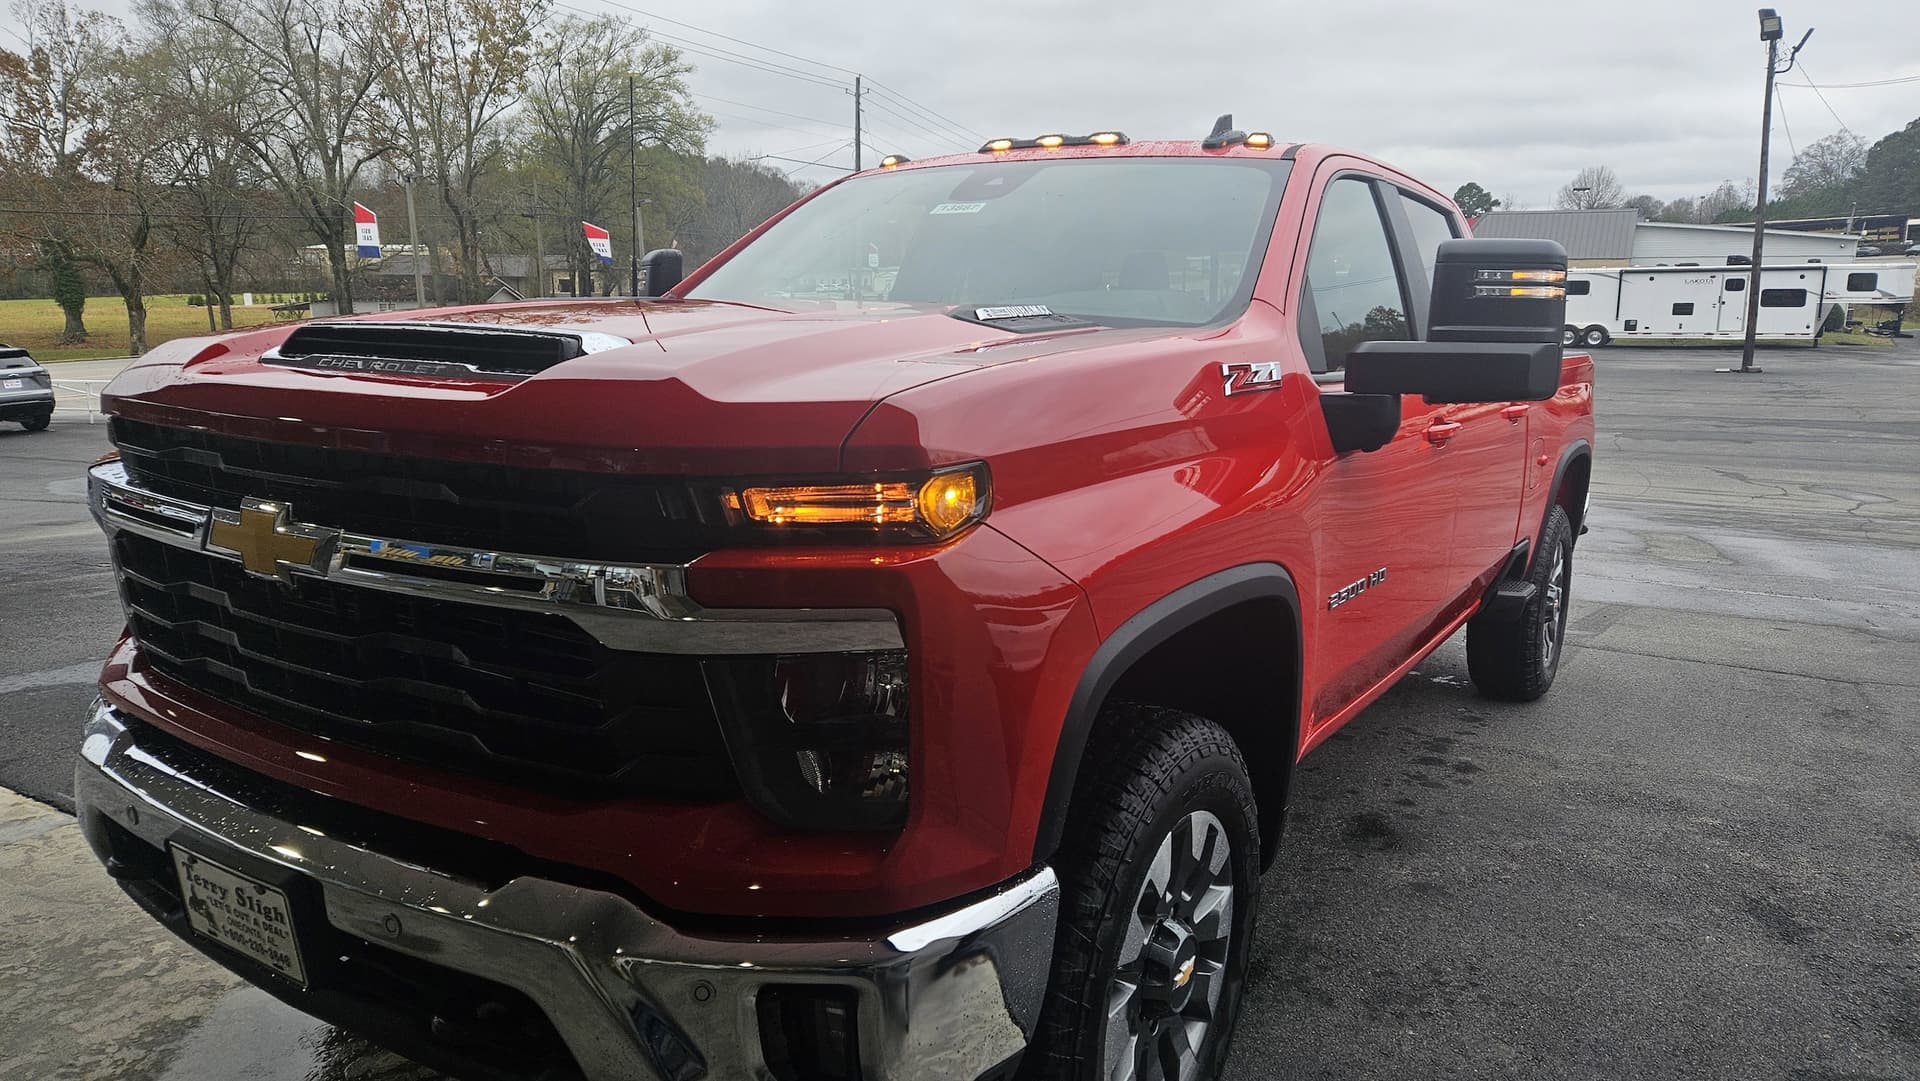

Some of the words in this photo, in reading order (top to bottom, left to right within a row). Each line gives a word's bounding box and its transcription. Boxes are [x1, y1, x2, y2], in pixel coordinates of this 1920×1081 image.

[316, 357, 447, 374] CHEVROLET
[1328, 577, 1366, 611] 2500
[1368, 567, 1387, 589] HD
[181, 861, 228, 900] Terry
[235, 887, 286, 925] Sligh
